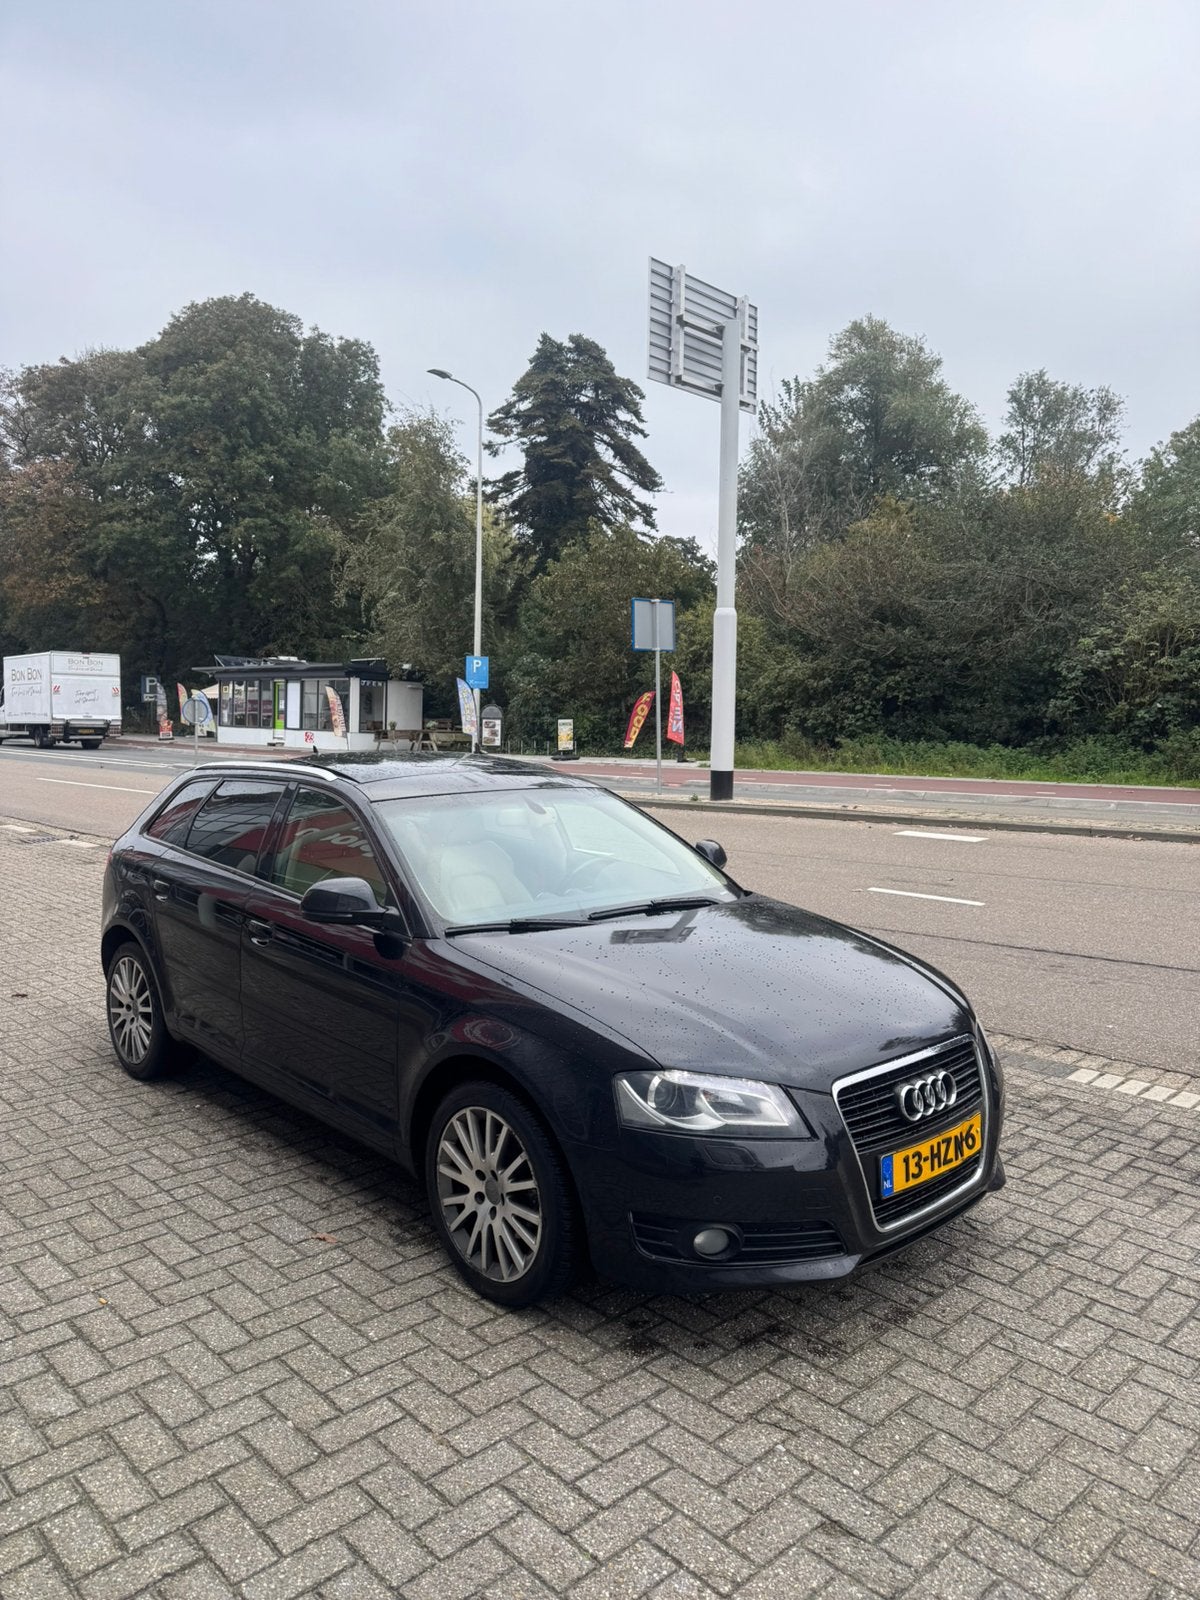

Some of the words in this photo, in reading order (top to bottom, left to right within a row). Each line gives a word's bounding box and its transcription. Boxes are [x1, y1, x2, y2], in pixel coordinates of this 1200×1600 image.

[473, 660, 482, 673] P
[11, 668, 26, 682] BON
[27, 667, 42, 681] BON
[145, 677, 157, 693] P
[883, 1179, 892, 1188] NL
